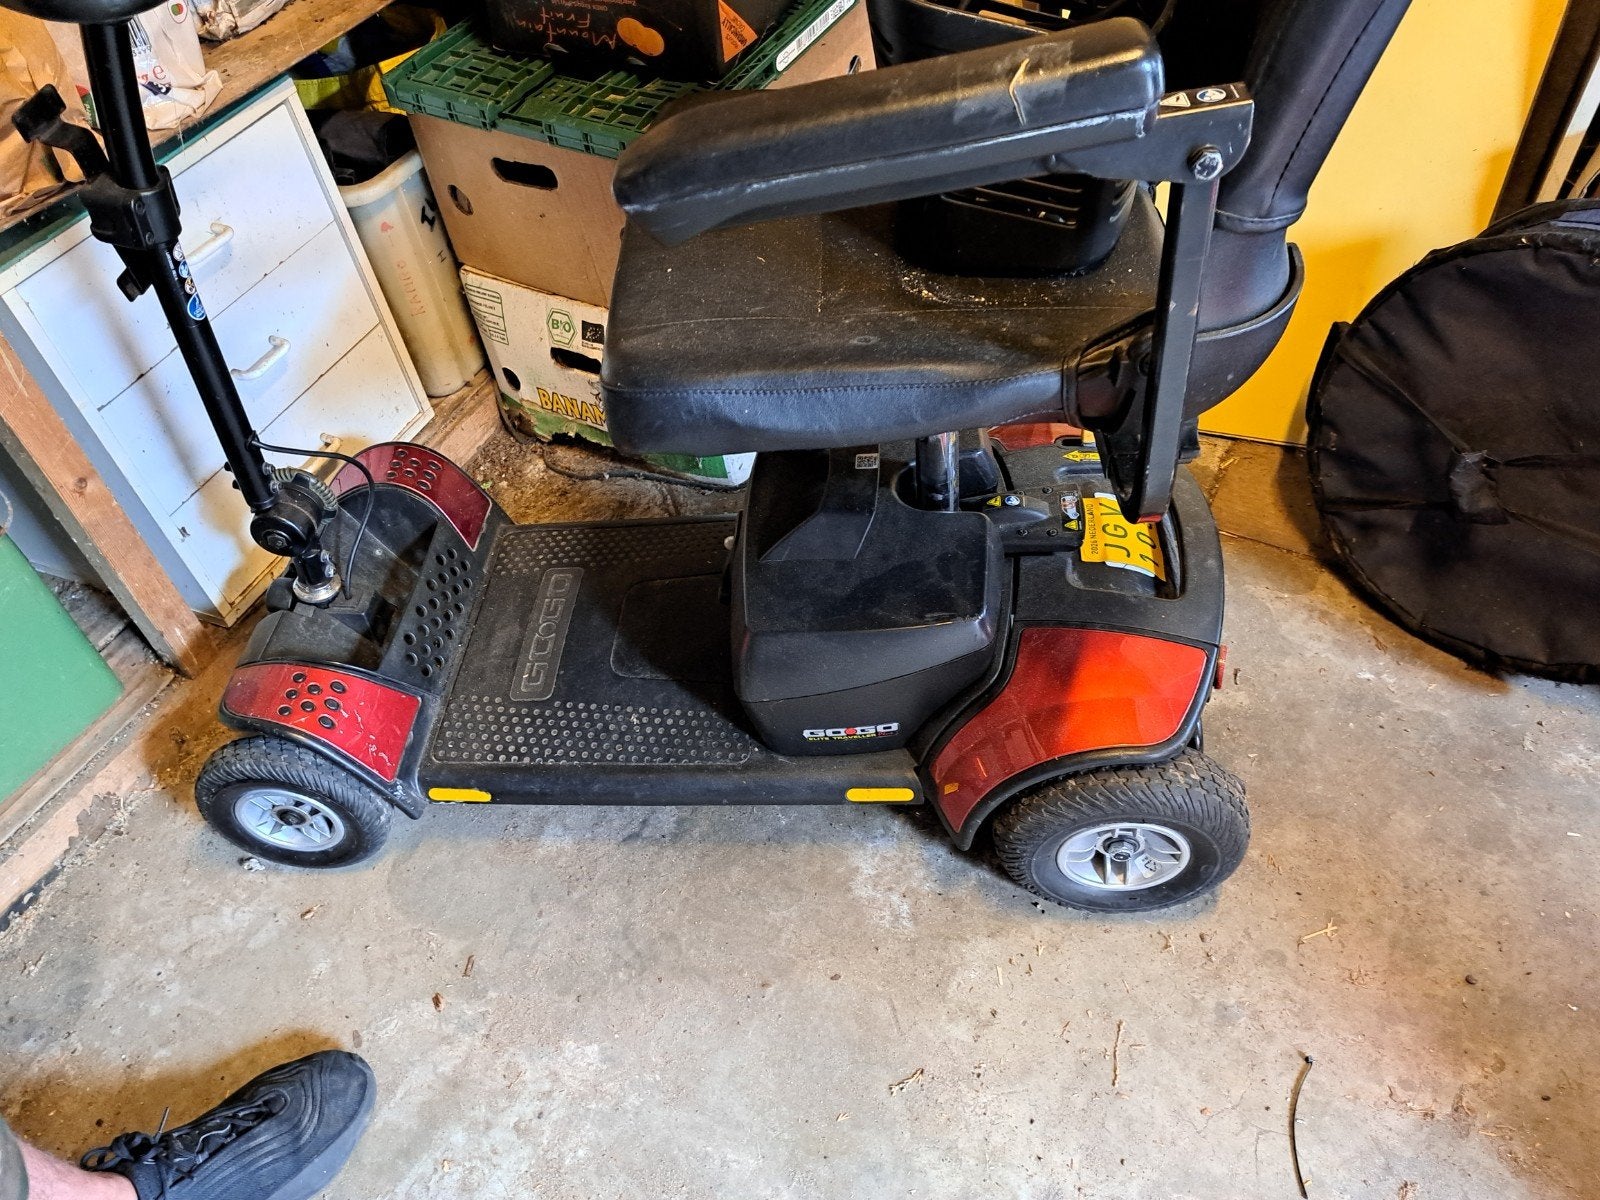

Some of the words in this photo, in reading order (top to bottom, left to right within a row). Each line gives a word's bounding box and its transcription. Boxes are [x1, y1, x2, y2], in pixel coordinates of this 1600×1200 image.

[516, 18, 616, 50] Mountain
[540, 6, 590, 28] Fruit
[1086, 504, 1099, 539] NEDERLAND
[1099, 503, 1130, 558] JGV
[1136, 523, 1159, 567] 10
